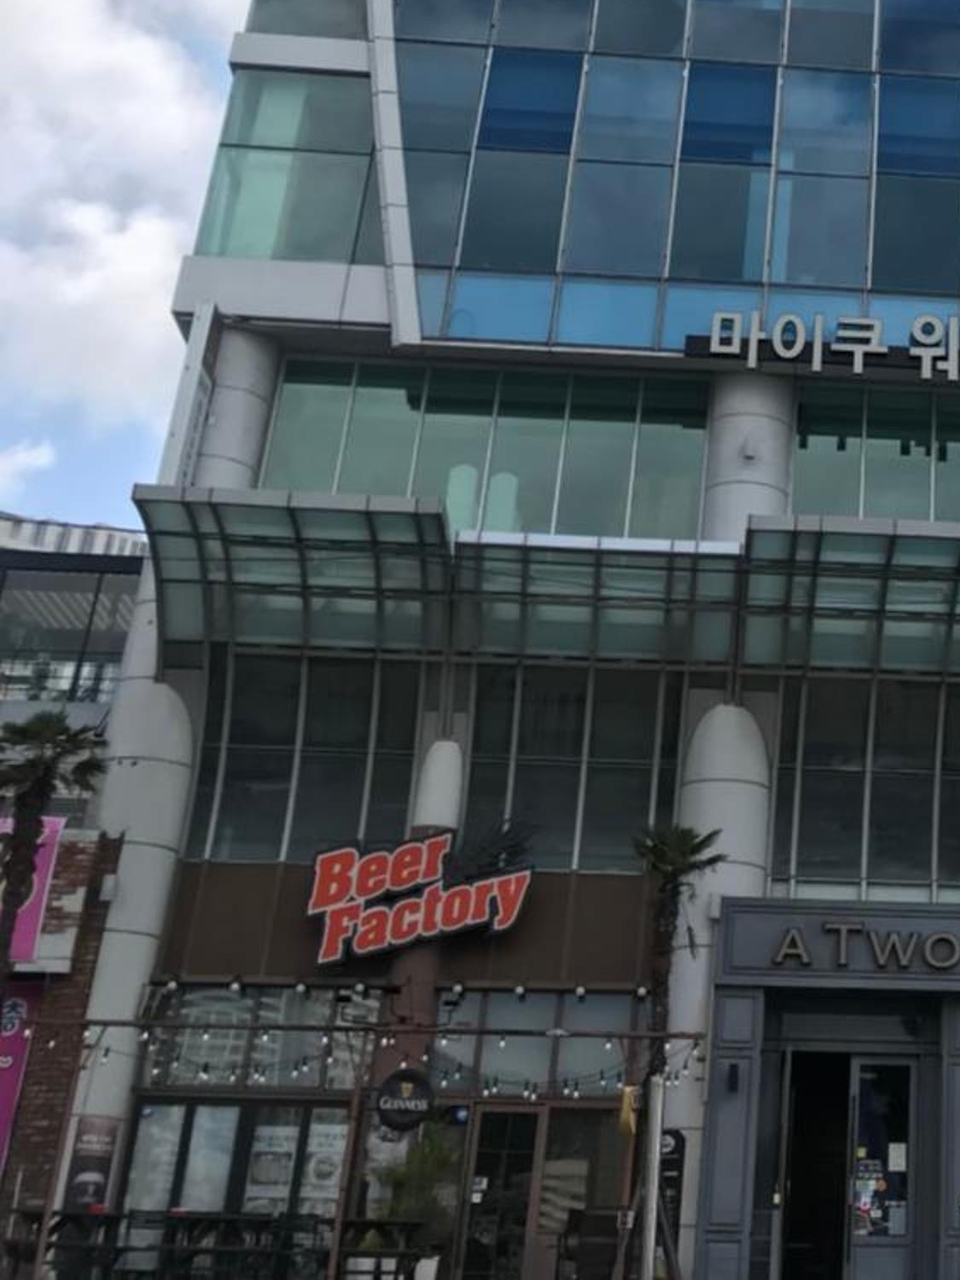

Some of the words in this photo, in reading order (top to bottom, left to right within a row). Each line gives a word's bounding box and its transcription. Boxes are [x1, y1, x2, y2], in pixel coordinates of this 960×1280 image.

[709, 310, 889, 374] 마이쿠
[308, 832, 451, 915] Beer
[318, 870, 531, 964] Factory
[773, 926, 811, 967] A
